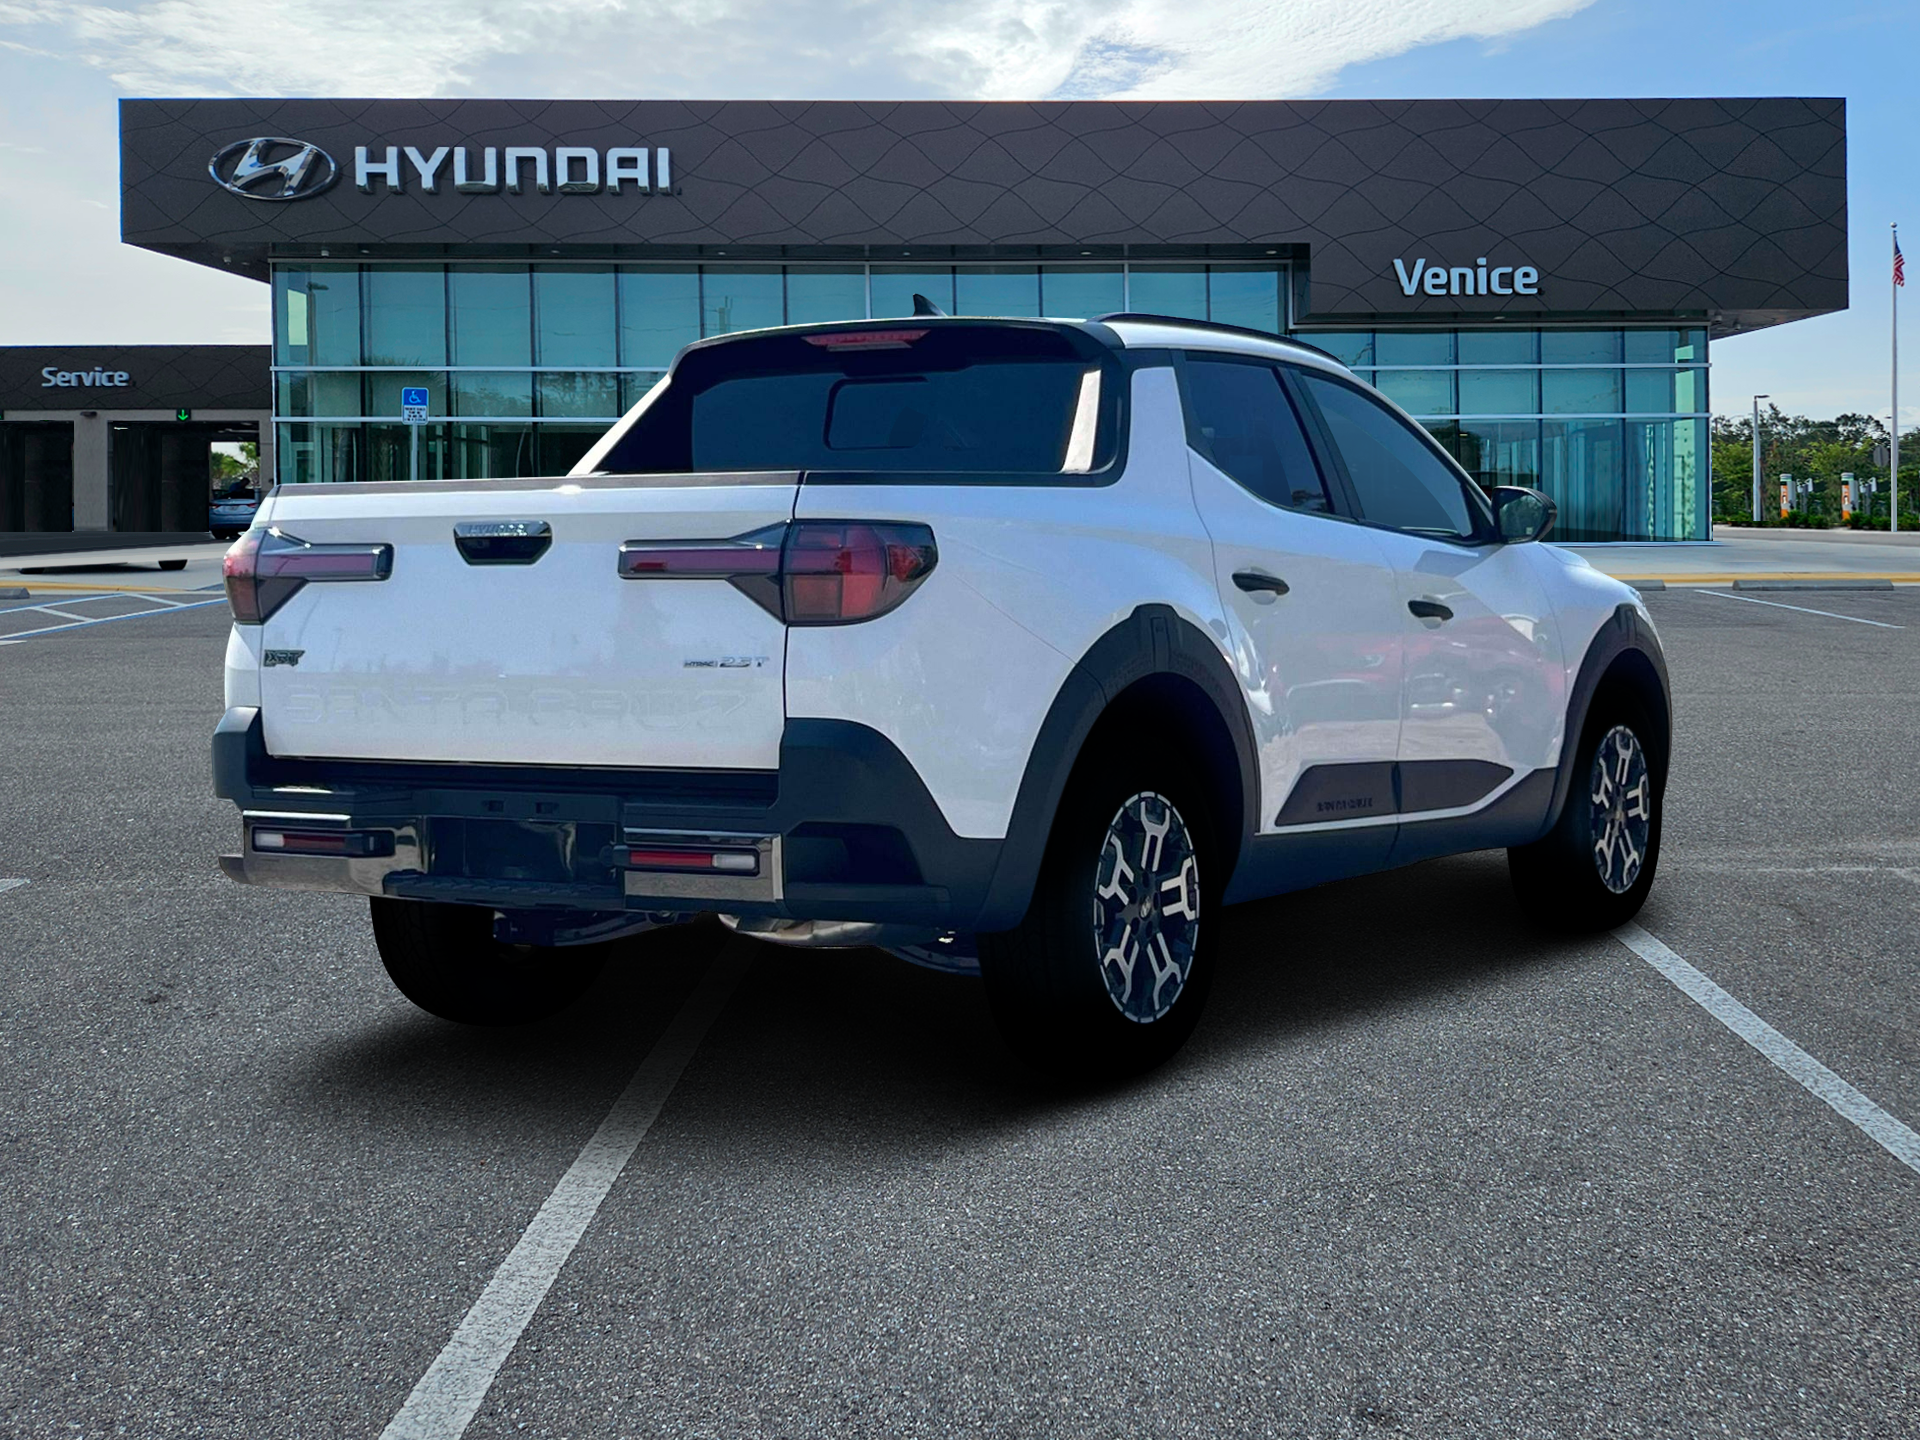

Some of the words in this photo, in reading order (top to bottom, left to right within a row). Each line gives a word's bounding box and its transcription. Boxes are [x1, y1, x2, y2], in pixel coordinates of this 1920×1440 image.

[355, 146, 672, 193] HYUNDAI
[1393, 257, 1539, 296] Venice
[41, 366, 130, 387] Service
